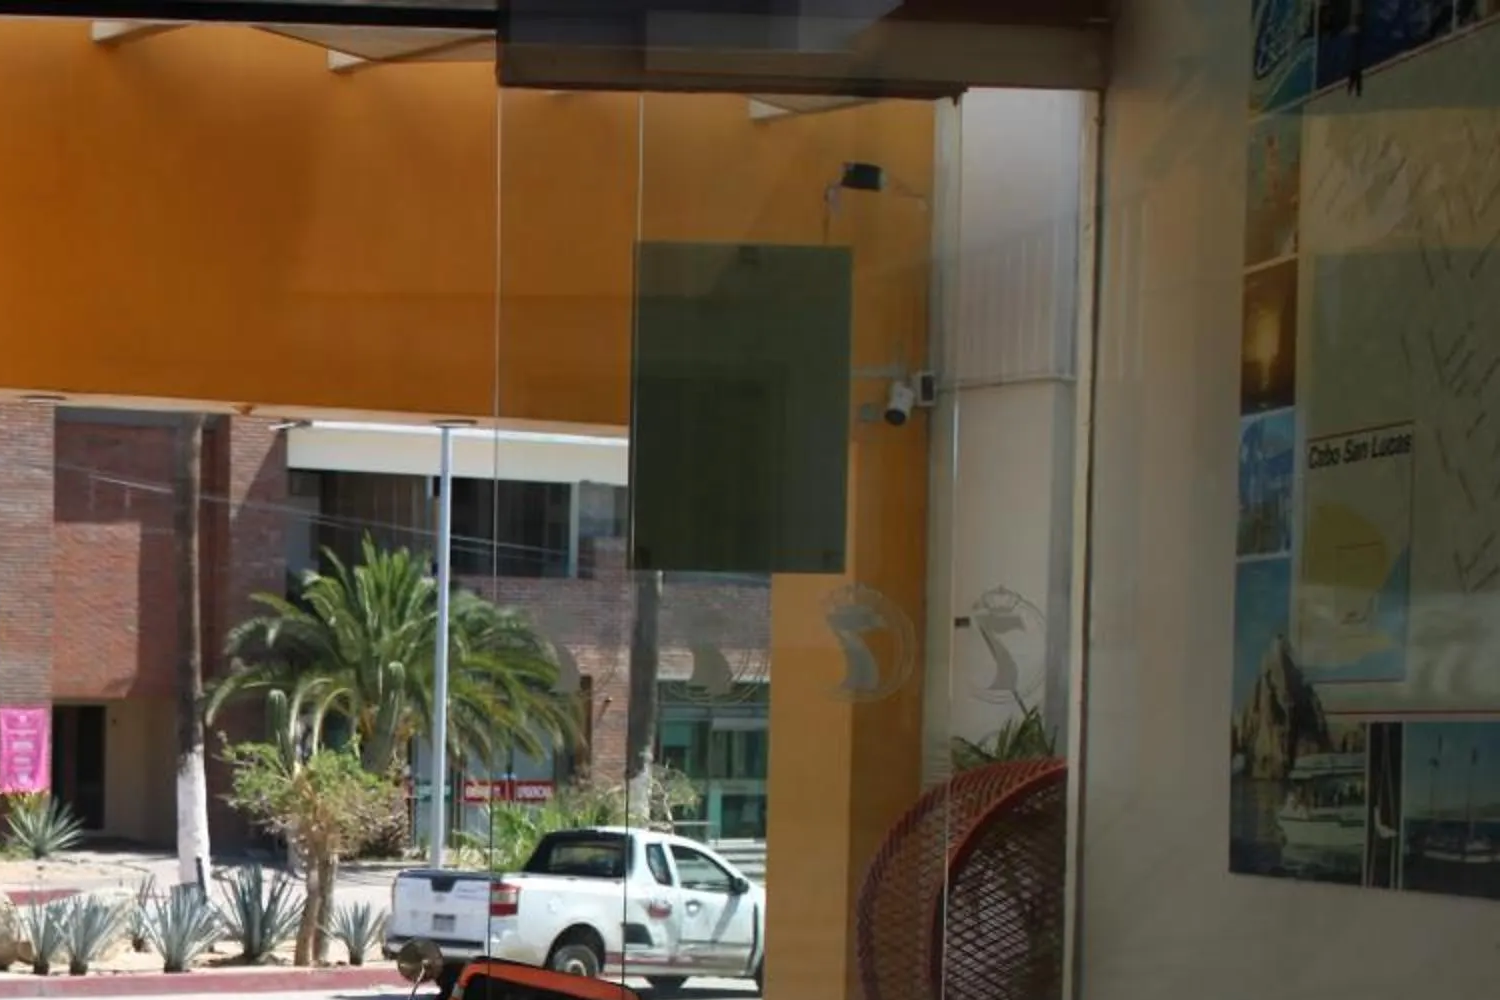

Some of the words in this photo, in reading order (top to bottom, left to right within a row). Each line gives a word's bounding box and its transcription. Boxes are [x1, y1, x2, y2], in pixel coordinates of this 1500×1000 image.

[1308, 443, 1342, 469] Cabo
[1343, 438, 1369, 464] San
[1371, 433, 1413, 458] Lucas
